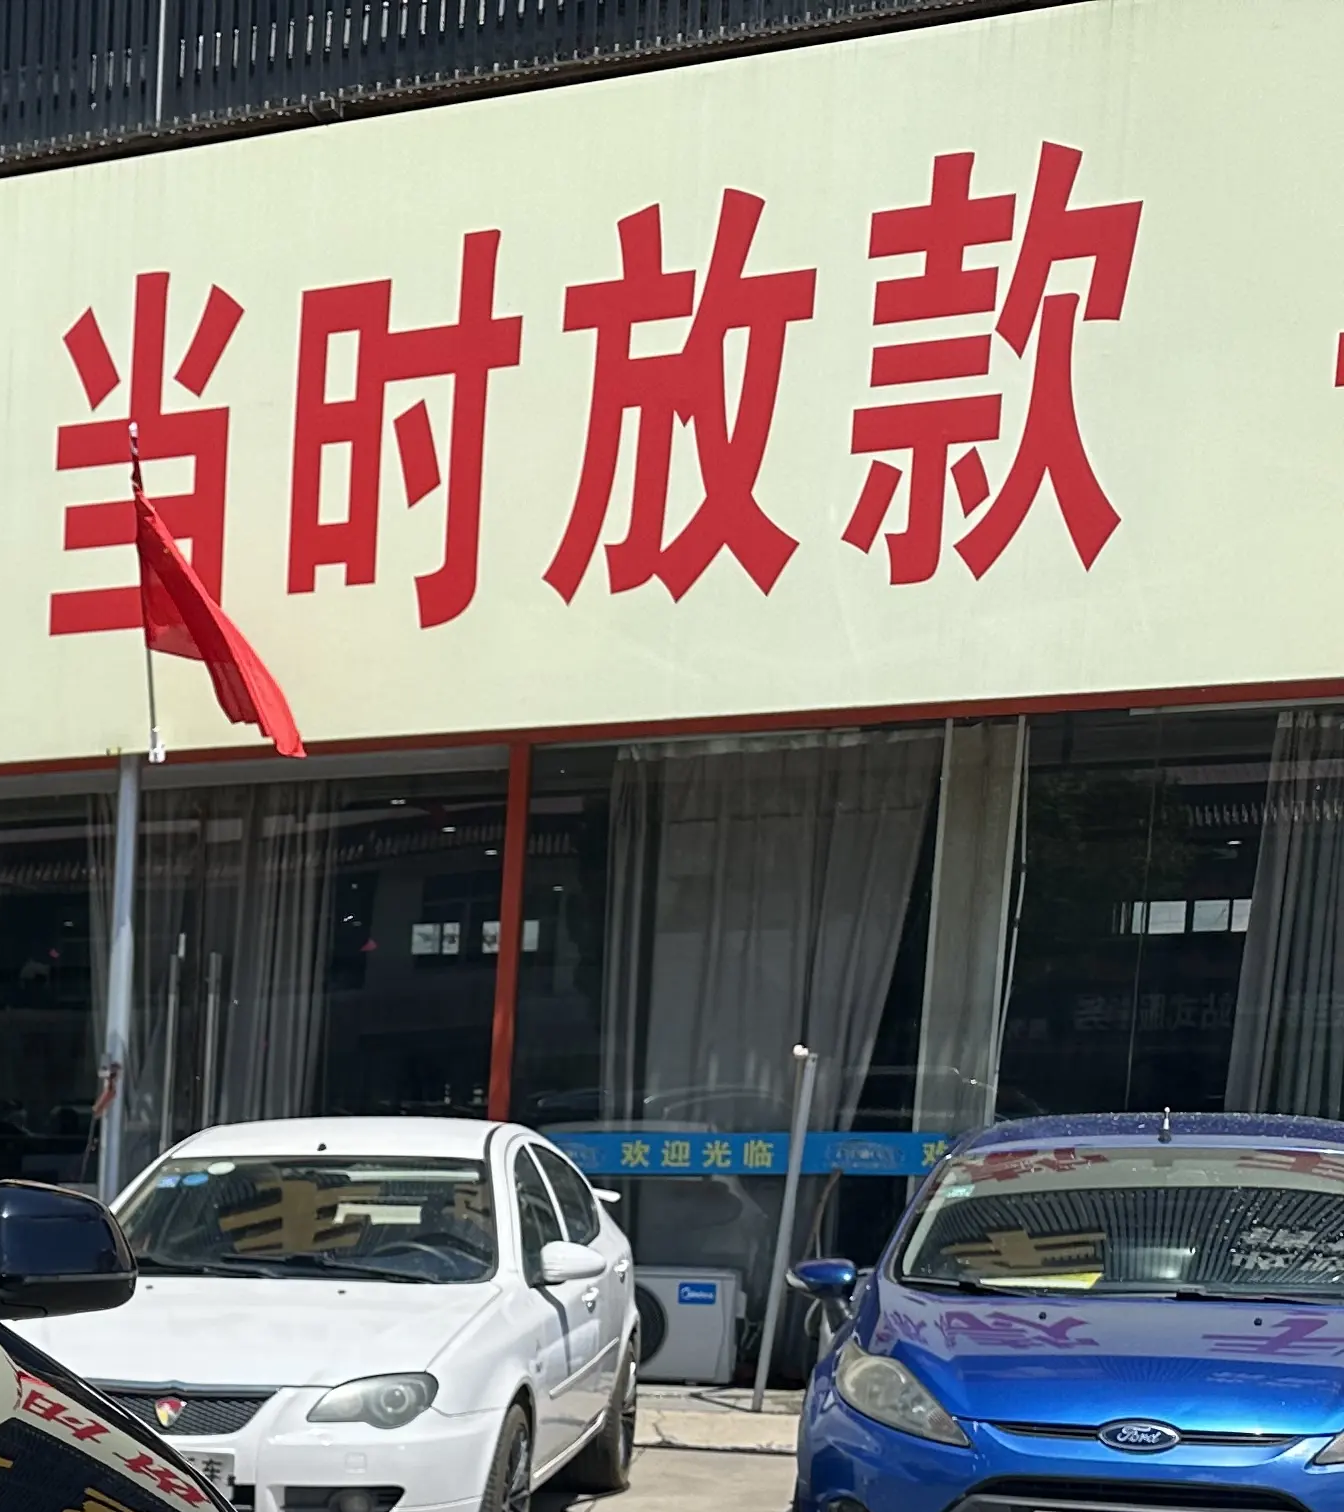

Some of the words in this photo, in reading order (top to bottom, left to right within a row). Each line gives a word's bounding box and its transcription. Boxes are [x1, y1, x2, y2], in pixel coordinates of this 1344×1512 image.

[49, 140, 1143, 636] 当时放款
[621, 1139, 775, 1169] 欢迎光临
[1117, 1425, 1162, 1444] Ford
